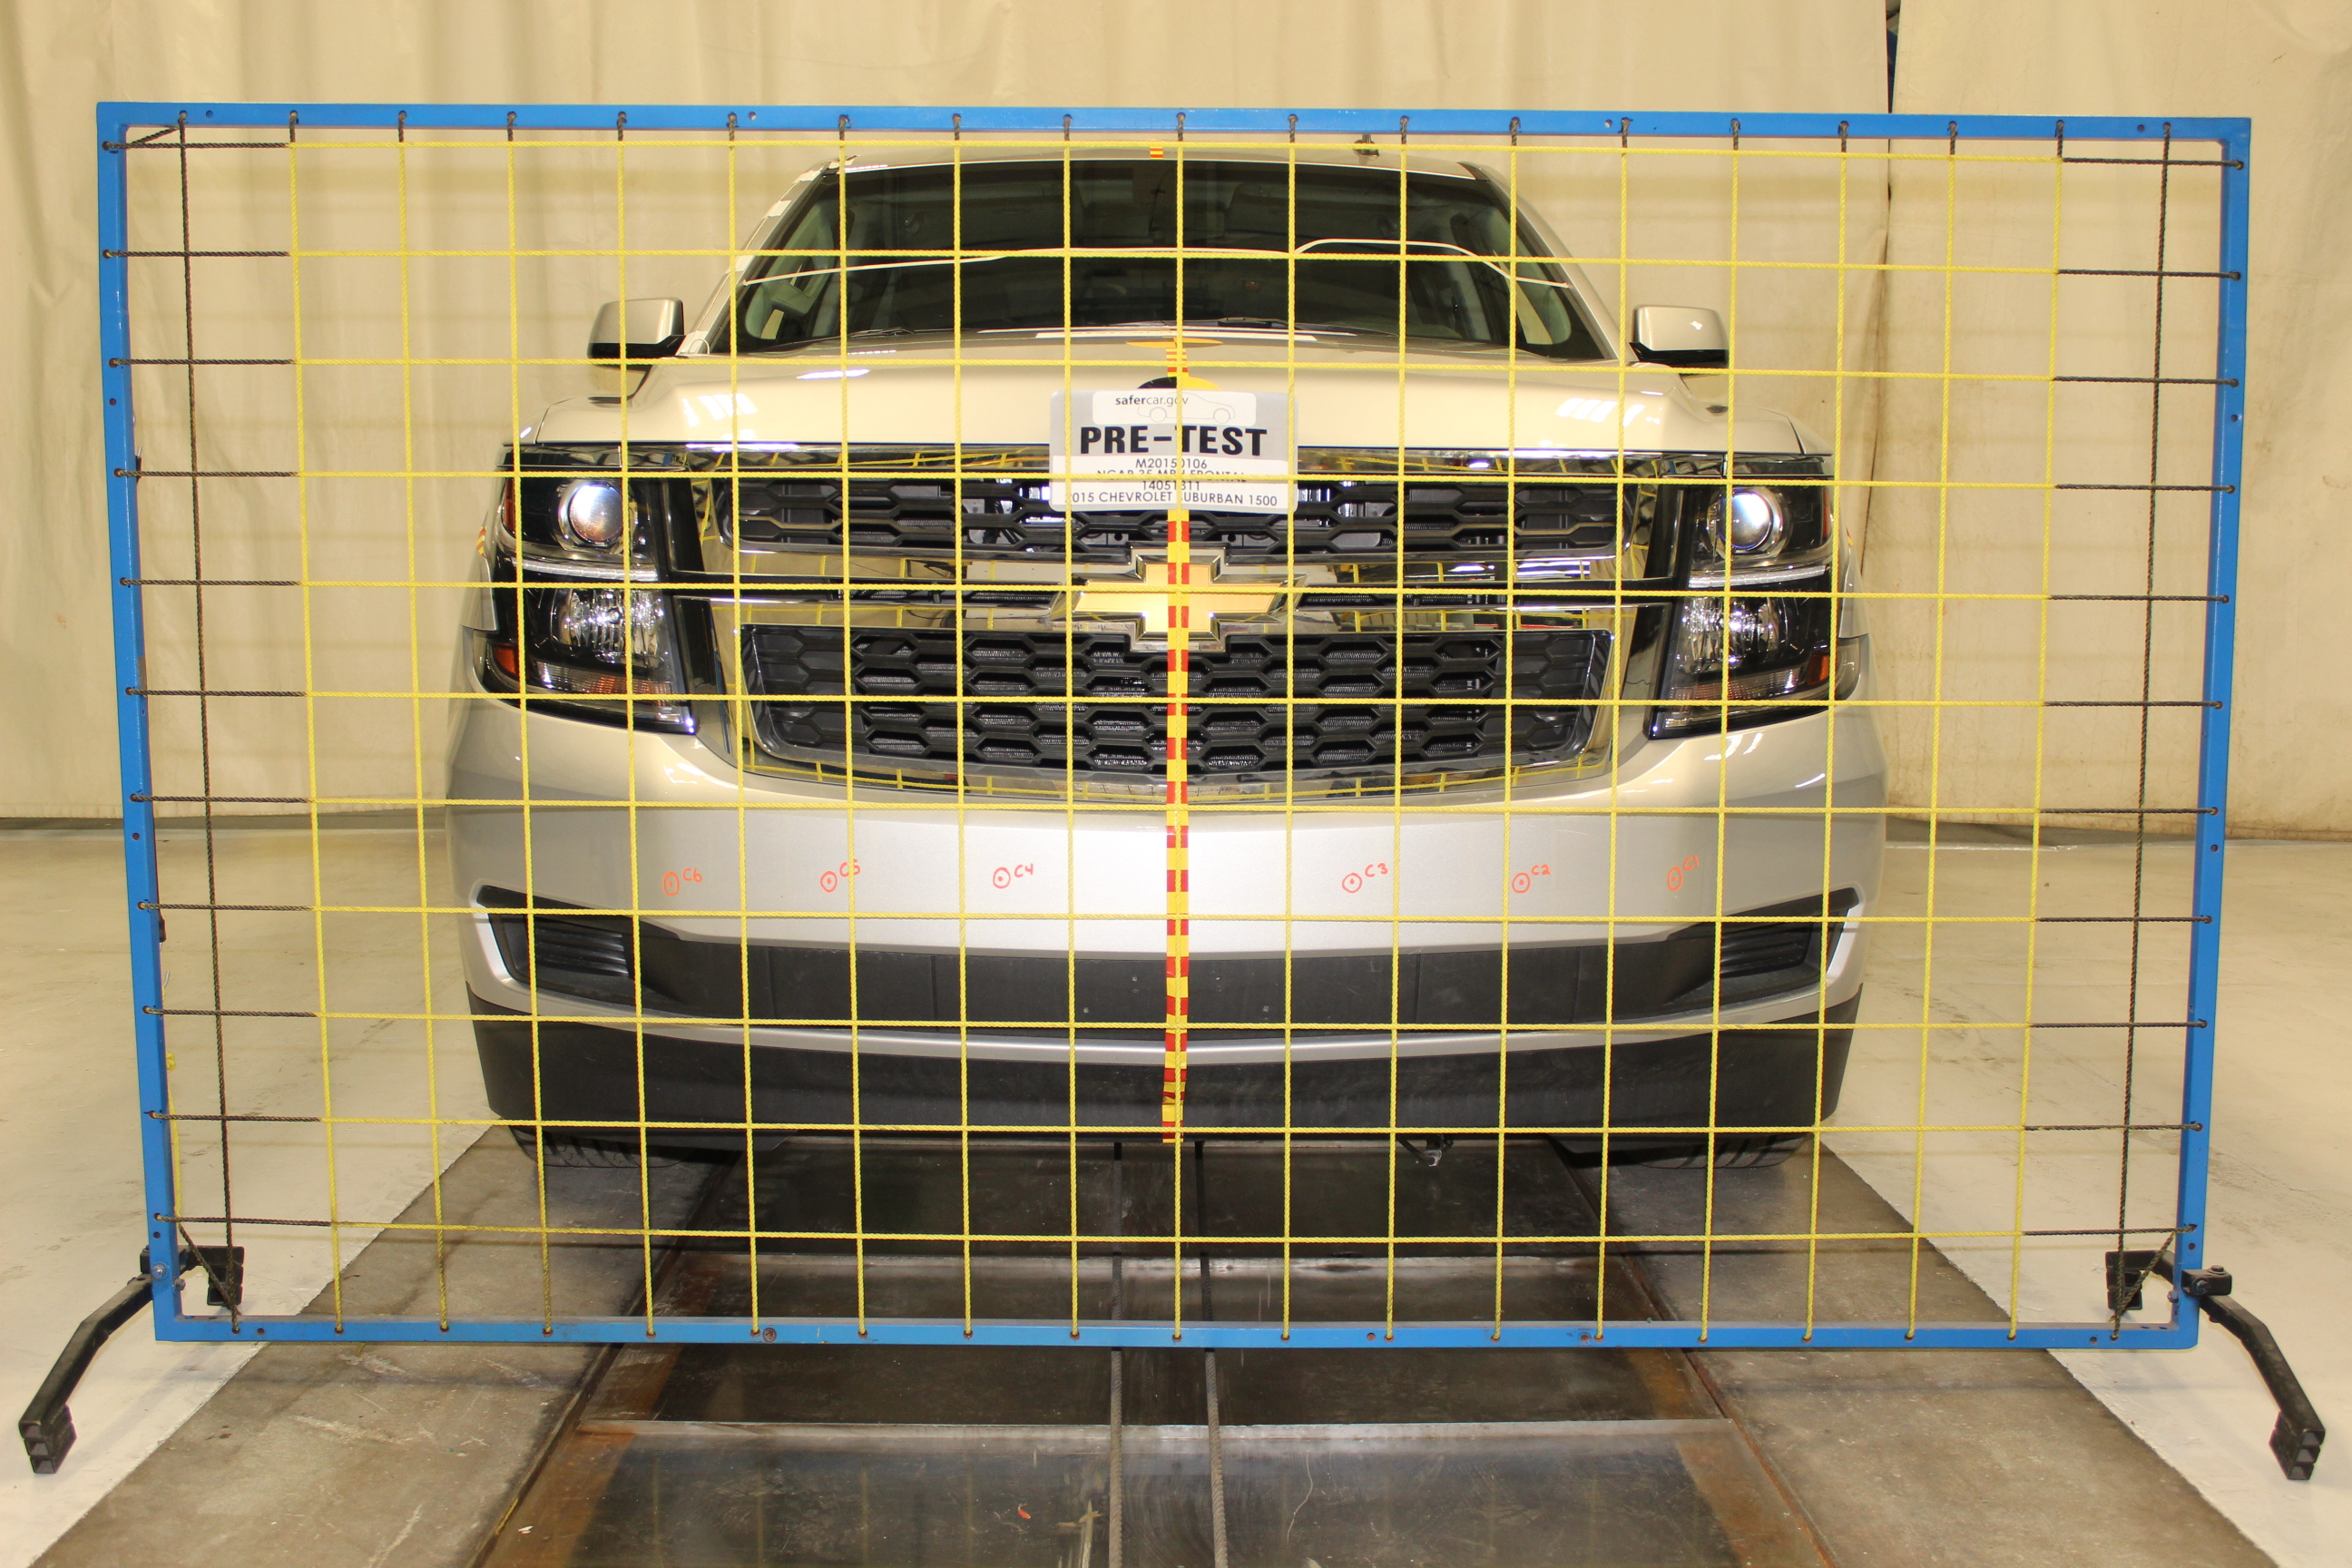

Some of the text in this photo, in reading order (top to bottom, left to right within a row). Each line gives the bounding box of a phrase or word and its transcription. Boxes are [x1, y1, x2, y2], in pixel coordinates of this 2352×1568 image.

[1080, 425, 1268, 456] PRE-TEST
[1065, 491, 1278, 506] 015 CHEVROLET UBURBAN 1500
[1014, 863, 1034, 878] C4
[1365, 863, 1388, 877] C3
[1531, 864, 1552, 876] C2
[1683, 855, 1700, 871] C1
[682, 867, 702, 883] C6
